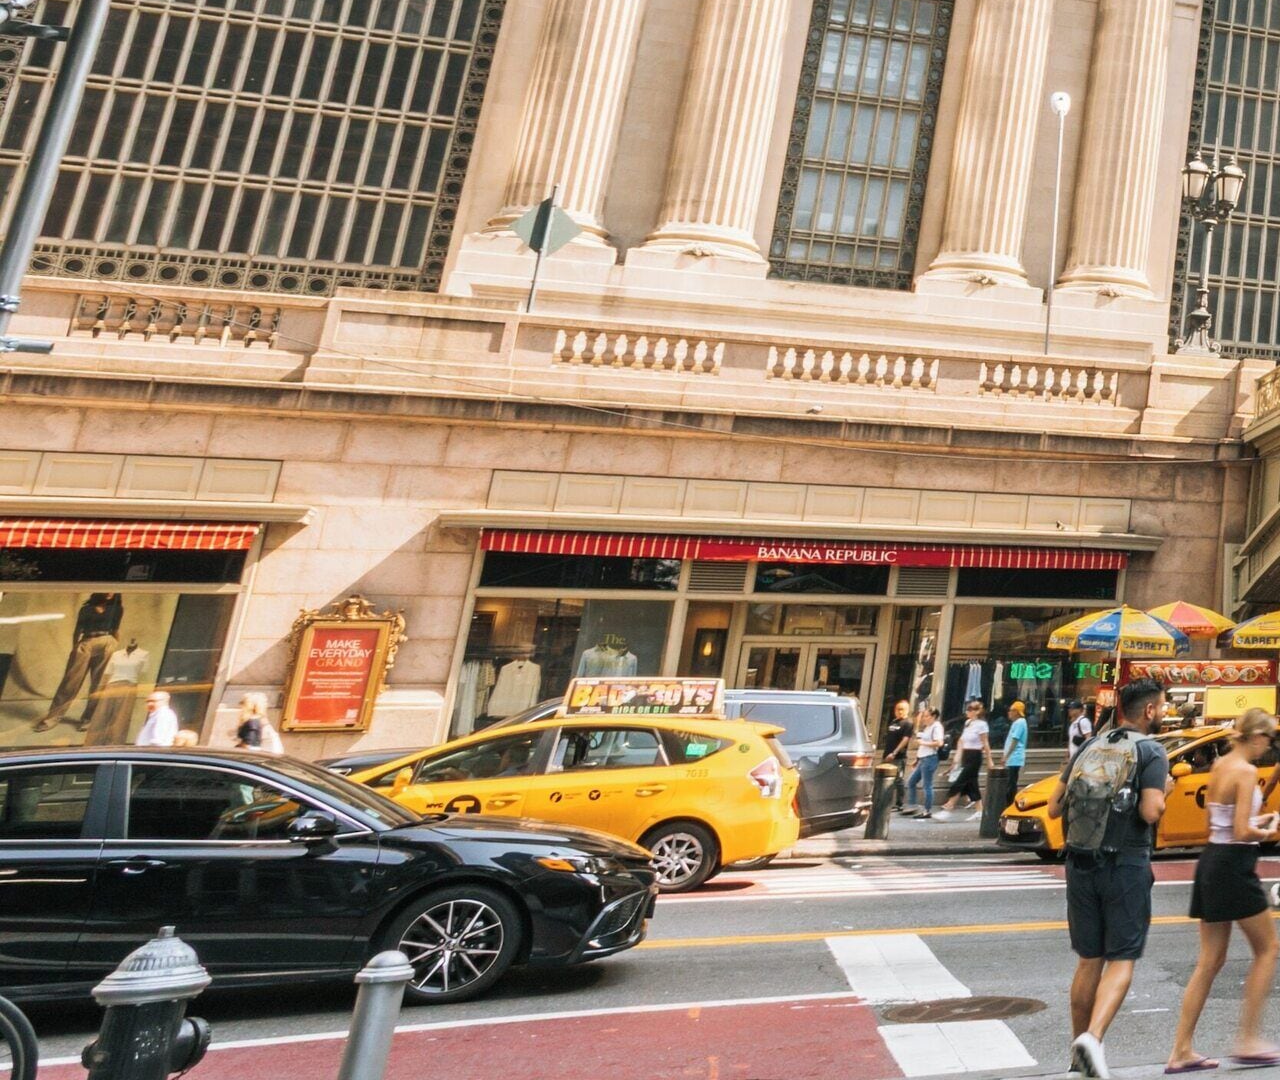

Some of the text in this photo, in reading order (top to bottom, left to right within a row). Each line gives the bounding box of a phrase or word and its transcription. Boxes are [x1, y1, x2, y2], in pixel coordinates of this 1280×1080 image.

[757, 546, 898, 562] BANANA REPUBLIC
[326, 639, 362, 649] MAKE
[603, 633, 626, 645] The
[1123, 640, 1171, 651] SABRETT
[310, 648, 373, 658] EVERYDAY
[315, 658, 364, 668] GRAND
[571, 684, 630, 707] BAD
